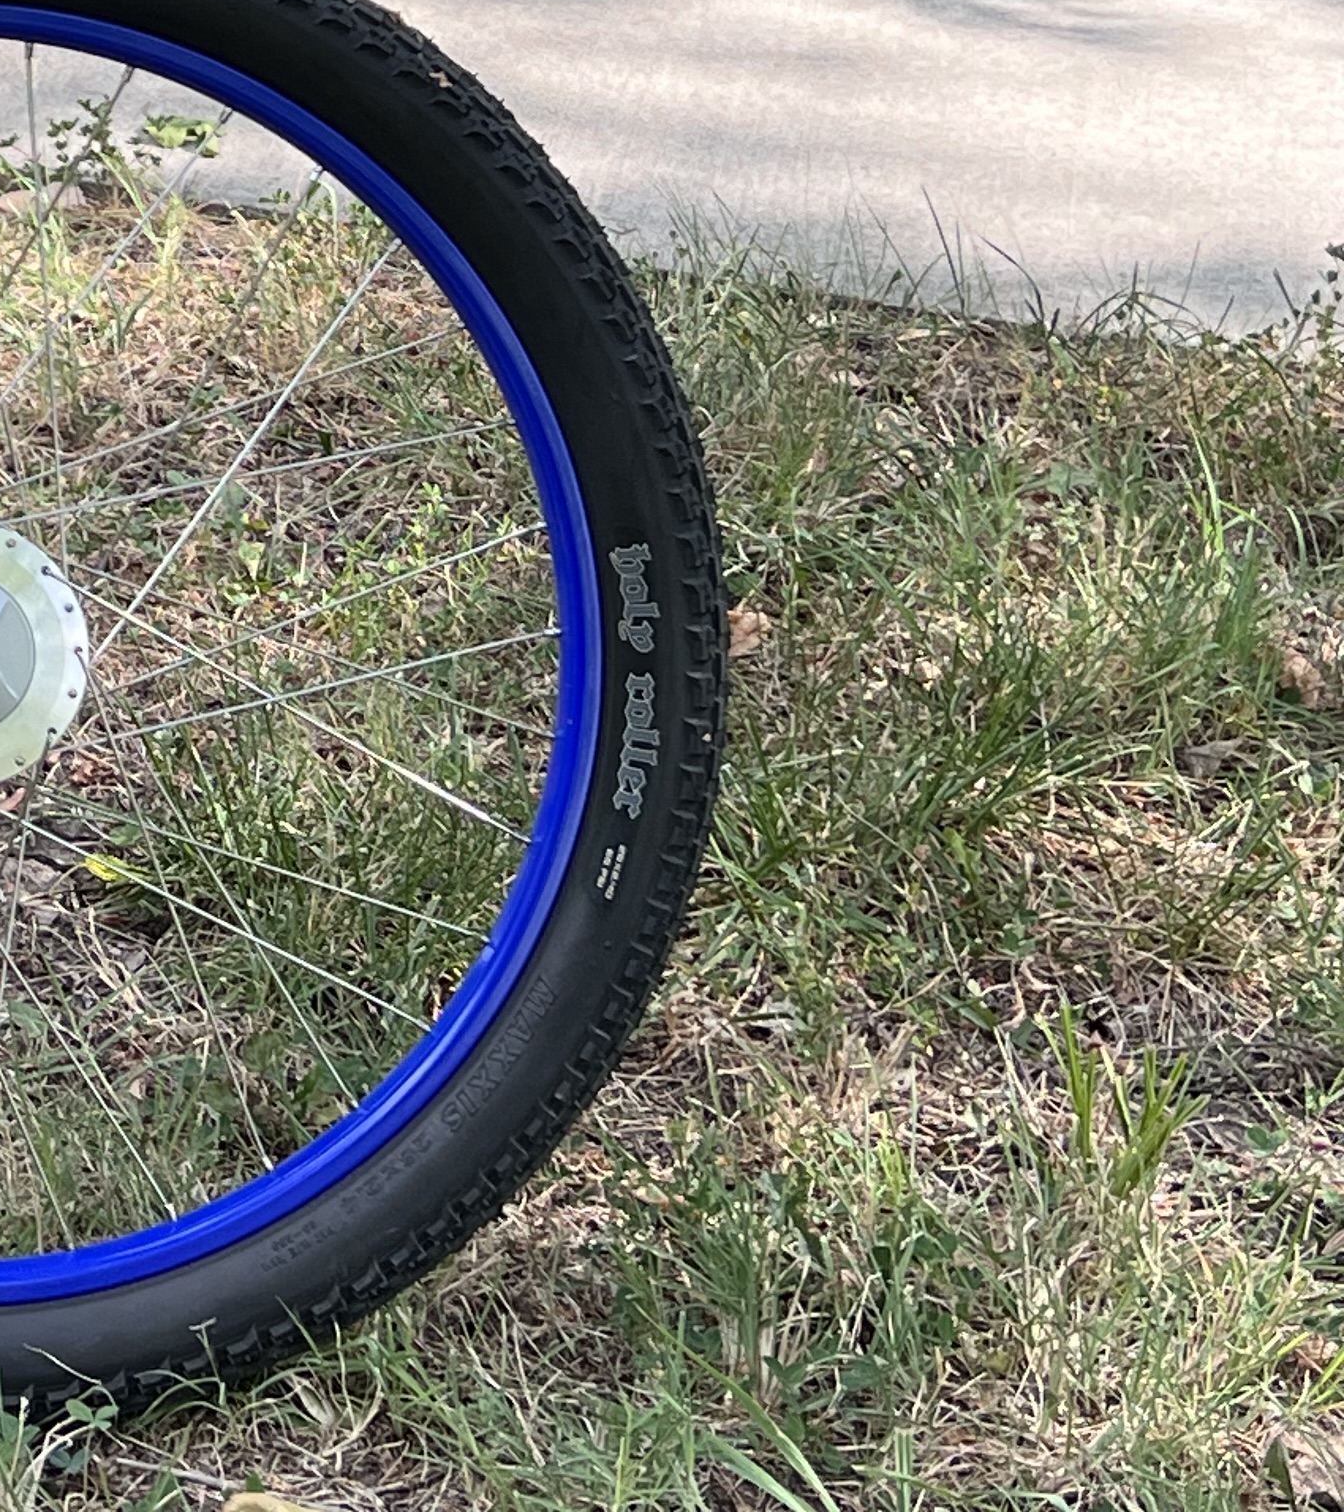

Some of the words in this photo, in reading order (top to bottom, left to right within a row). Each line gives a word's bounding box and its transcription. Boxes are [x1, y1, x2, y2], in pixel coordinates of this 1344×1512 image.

[610, 543, 661, 653] holy
[613, 672, 661, 820] roller
[441, 975, 557, 1133] MAXXIS
